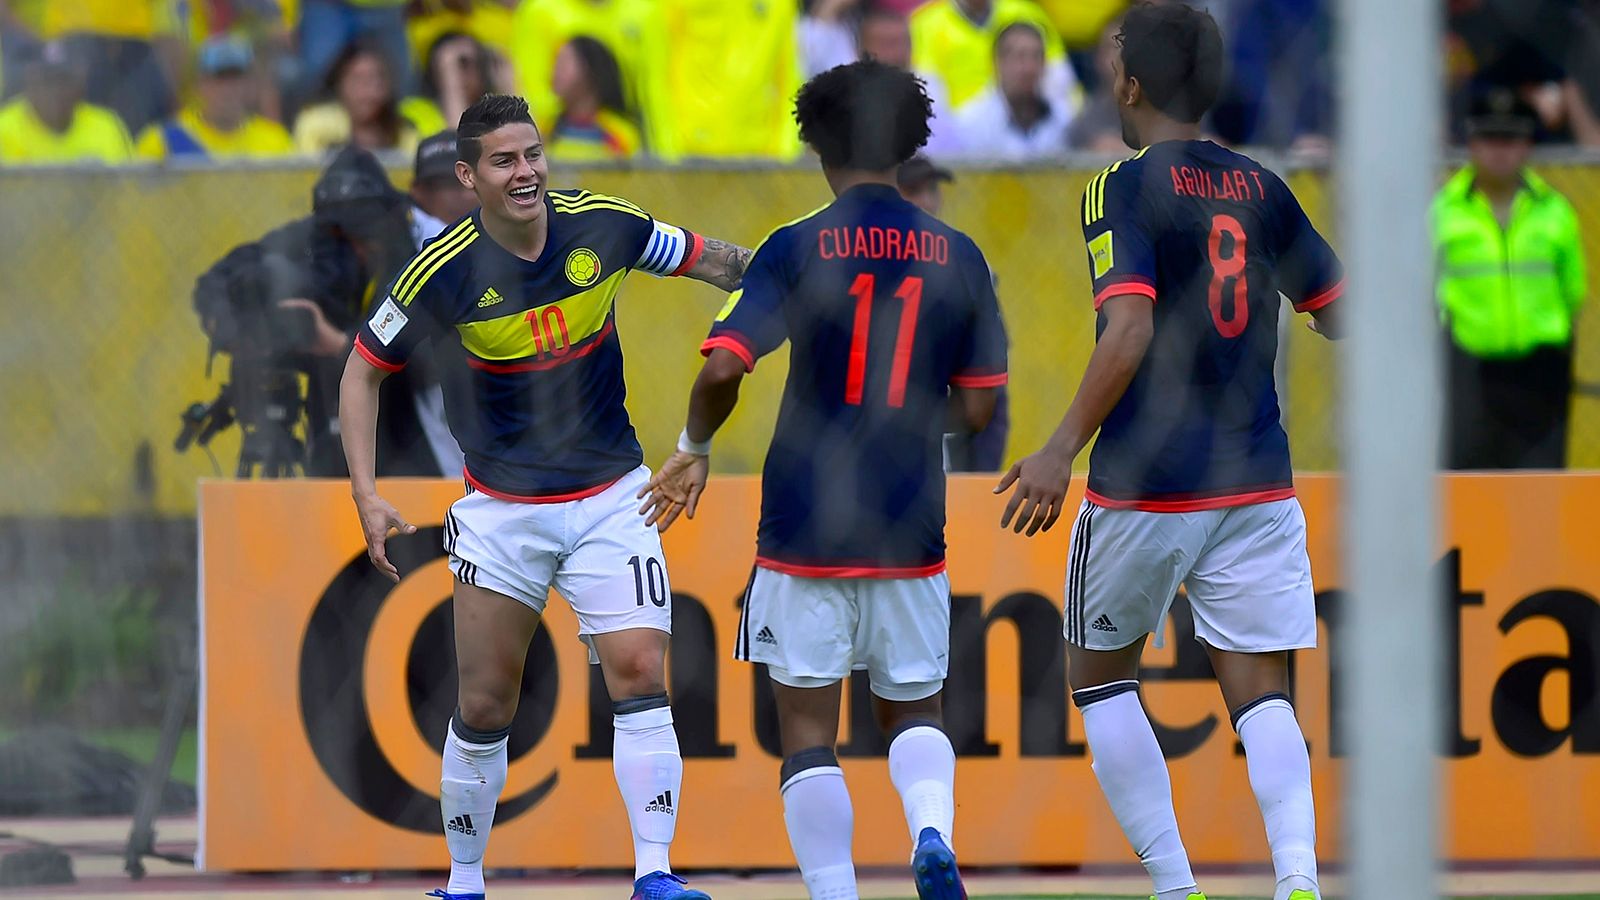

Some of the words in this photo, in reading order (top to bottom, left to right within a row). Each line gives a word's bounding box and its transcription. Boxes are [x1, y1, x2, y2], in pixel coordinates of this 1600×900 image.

[1170, 166, 1250, 201] AGUILAR
[1250, 170, 1265, 200] T
[818, 227, 949, 265] CUADRADO
[1208, 214, 1249, 338] 8
[477, 296, 504, 309] adidas
[524, 305, 571, 360] 10
[844, 273, 924, 408] 11
[627, 555, 666, 607] 10
[447, 823, 478, 836] adidas
